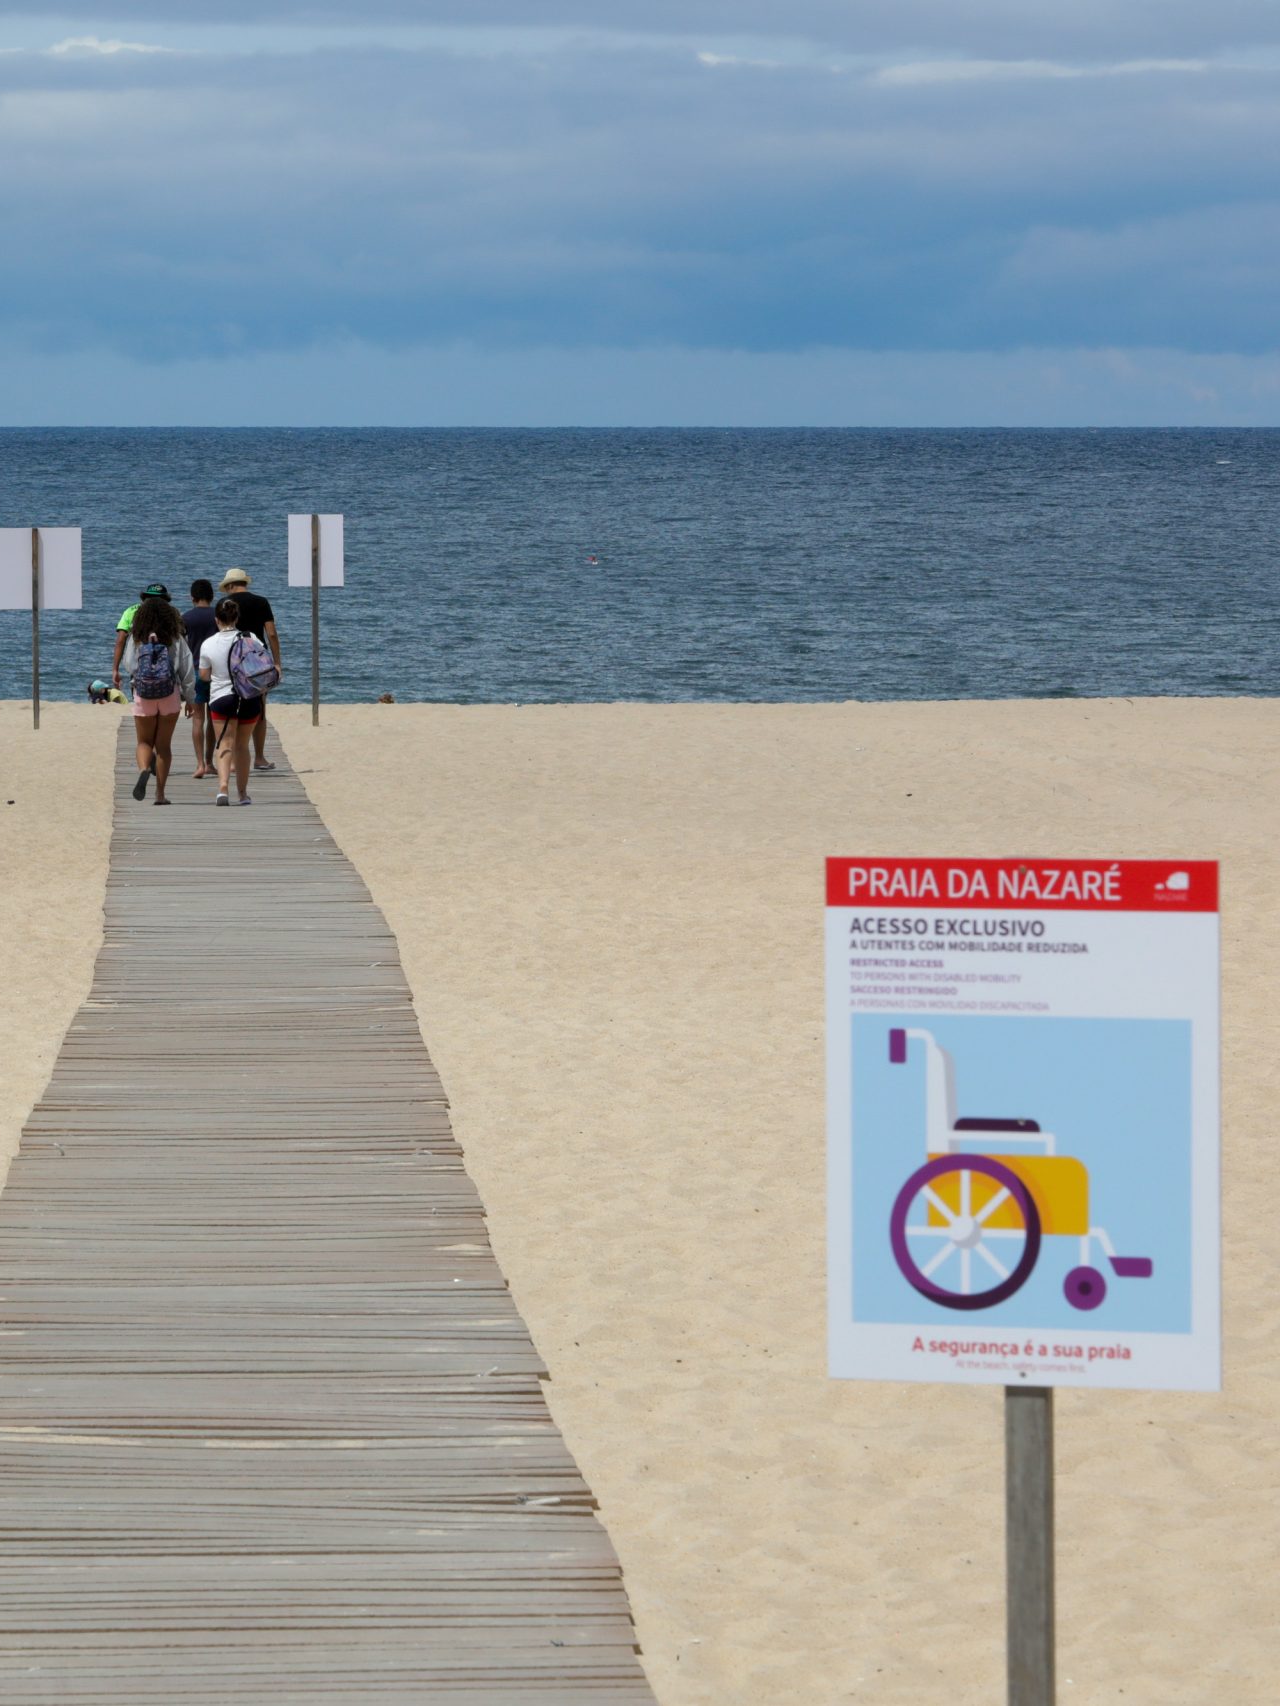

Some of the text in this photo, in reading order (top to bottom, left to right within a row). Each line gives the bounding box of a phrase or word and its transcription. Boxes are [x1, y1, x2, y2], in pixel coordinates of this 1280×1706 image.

[849, 863, 1122, 901] PRAIA DA NAZARÉ
[850, 917, 1046, 937] ACESSO EXCLUSIVO
[850, 939, 1089, 954] A UTENTES COM MOBILIDADE REDUZIDA
[849, 957, 944, 969] RESTRICTED ACCESS
[912, 1337, 1132, 1362] A segurança é a sua praia
